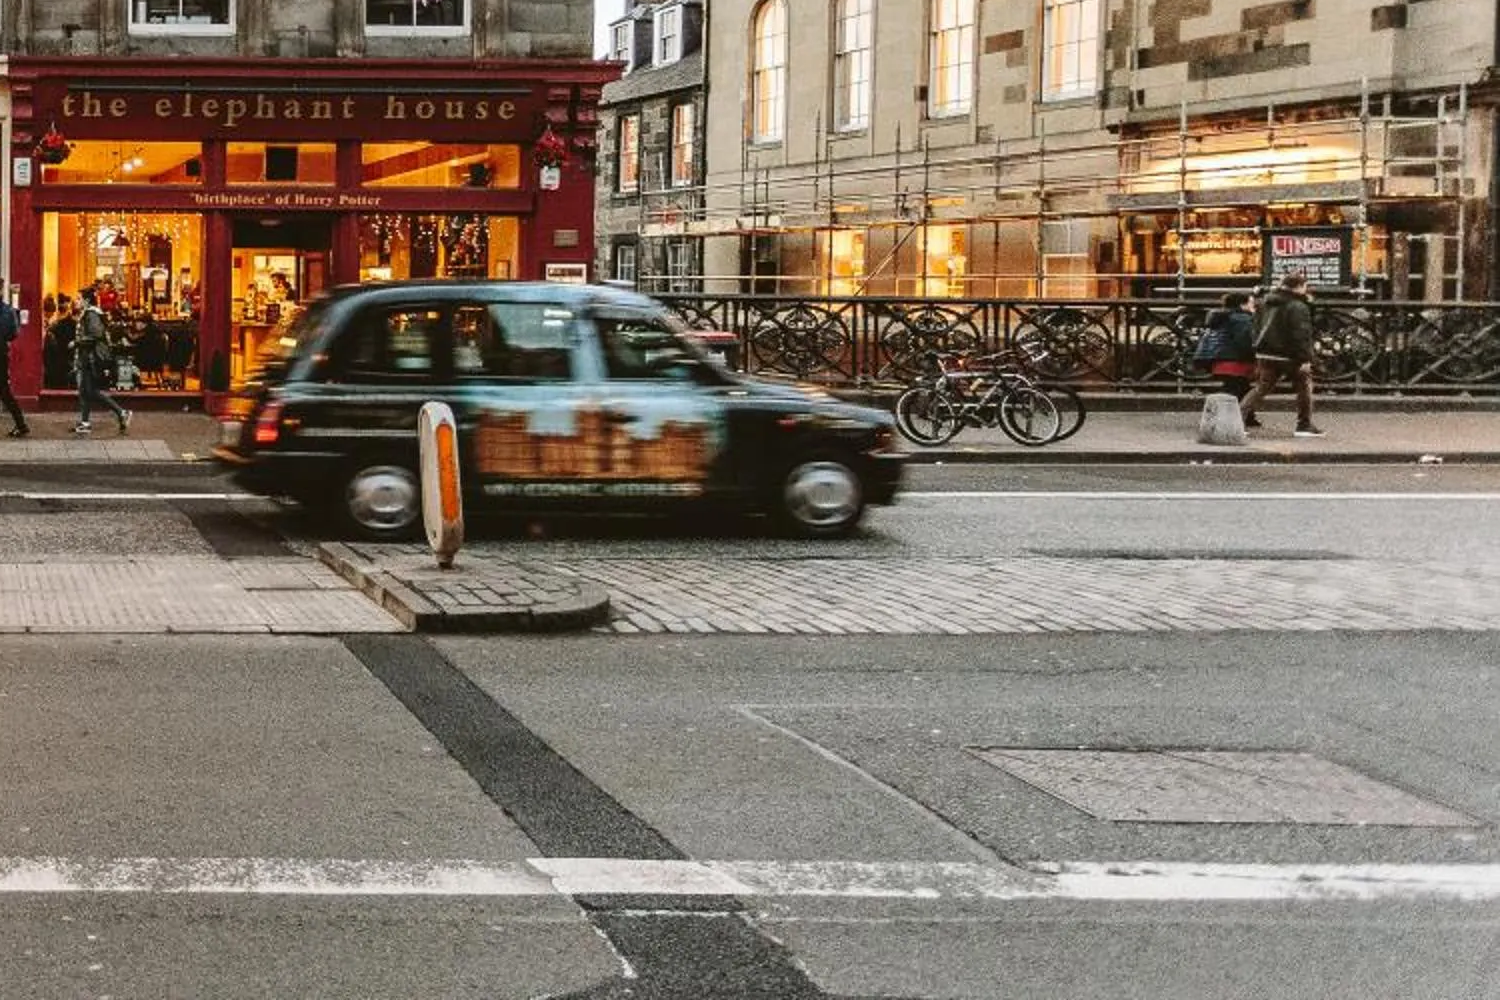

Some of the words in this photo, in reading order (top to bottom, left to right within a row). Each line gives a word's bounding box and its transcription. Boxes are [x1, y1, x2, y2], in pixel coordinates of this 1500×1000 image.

[63, 91, 128, 118] the
[155, 93, 355, 127] elephant
[384, 95, 517, 120] house
[275, 193, 290, 206] of
[295, 194, 334, 208] Harry
[339, 195, 382, 206] Potter
